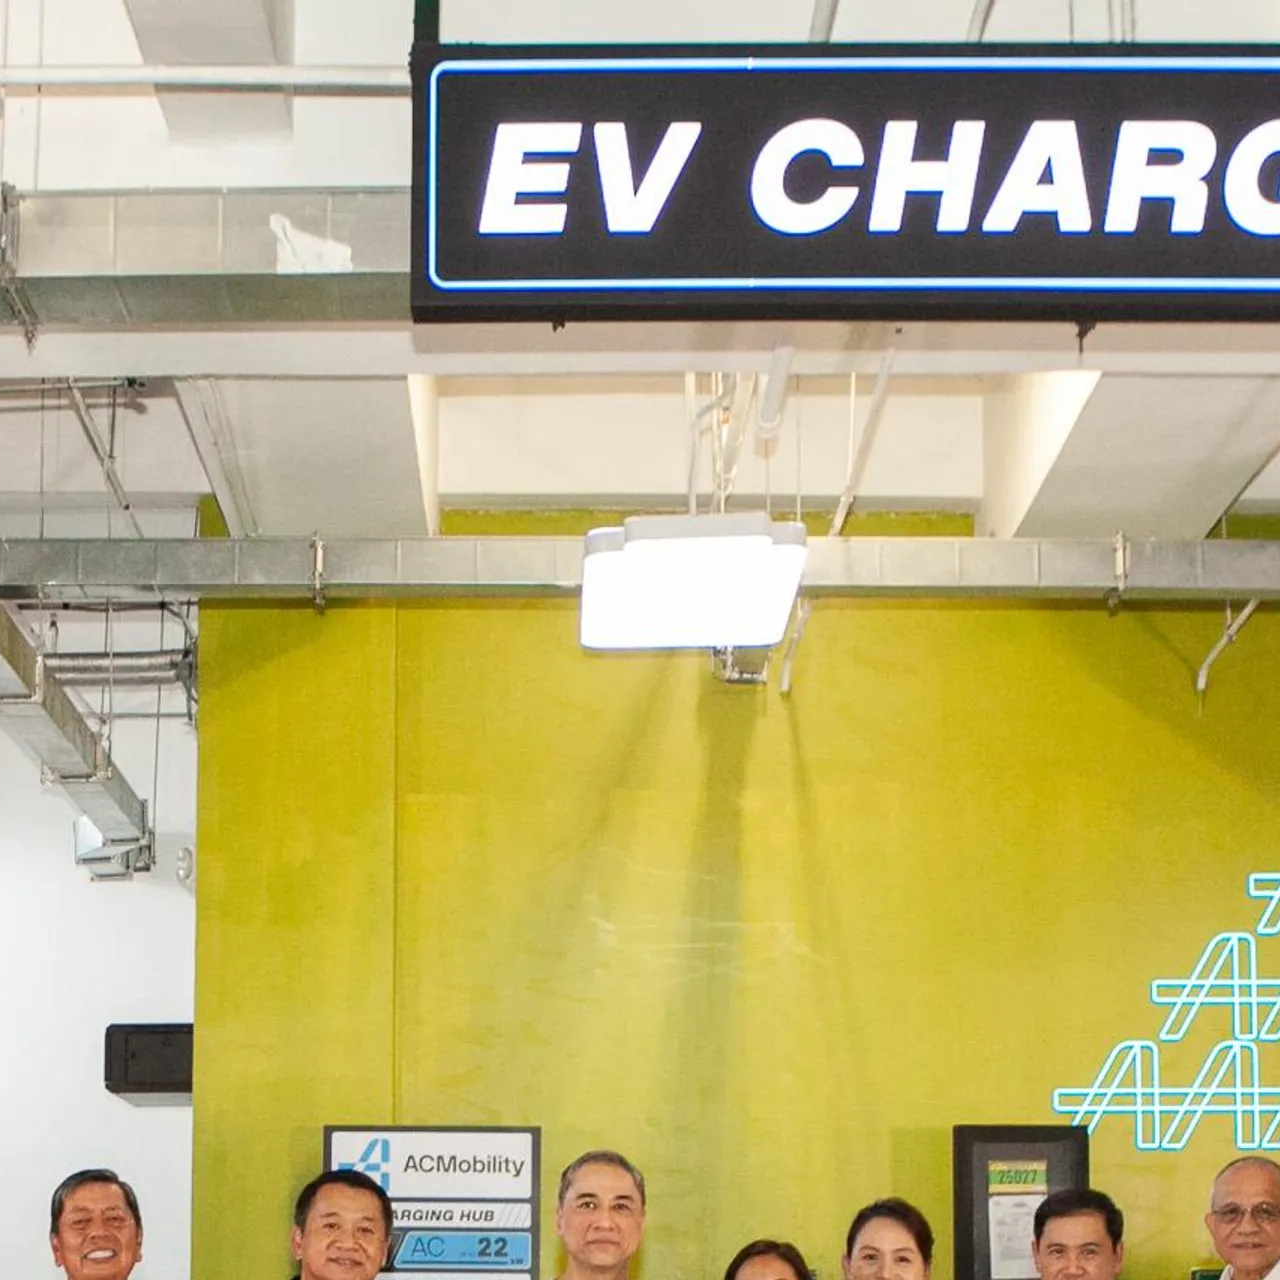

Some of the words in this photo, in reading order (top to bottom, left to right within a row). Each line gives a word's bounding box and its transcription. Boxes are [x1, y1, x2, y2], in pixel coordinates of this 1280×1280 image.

[477, 120, 703, 236] EV
[403, 1154, 525, 1177] ACMobility
[392, 1209, 455, 1222] ARGING
[459, 1209, 495, 1222] HUB
[410, 1235, 446, 1258] AC
[477, 1236, 509, 1258] 22
